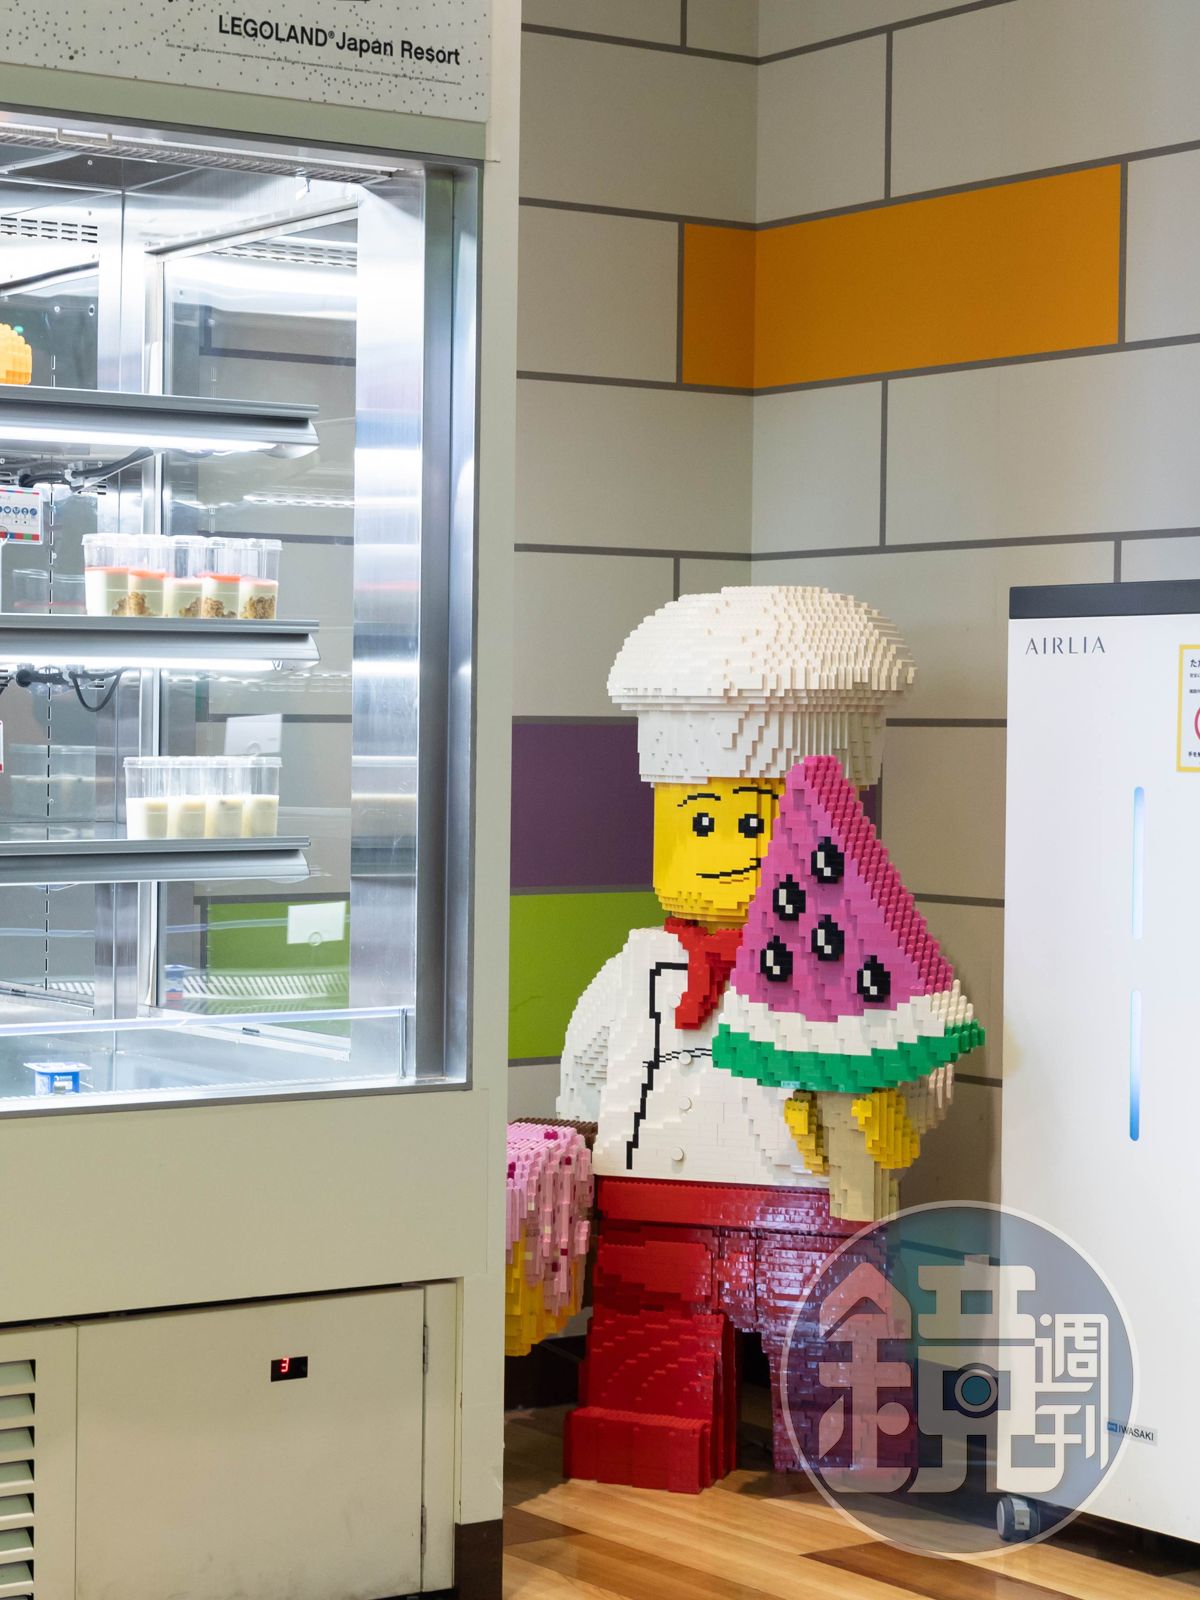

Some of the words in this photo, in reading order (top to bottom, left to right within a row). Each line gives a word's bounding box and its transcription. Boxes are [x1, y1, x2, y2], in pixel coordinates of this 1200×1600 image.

[336, 32, 394, 58] Japan
[400, 40, 460, 65] Resort
[1025, 636, 1106, 655] AIRLIA
[280, 1357, 290, 1373] 3
[1118, 1424, 1154, 1441] IWASAKI
